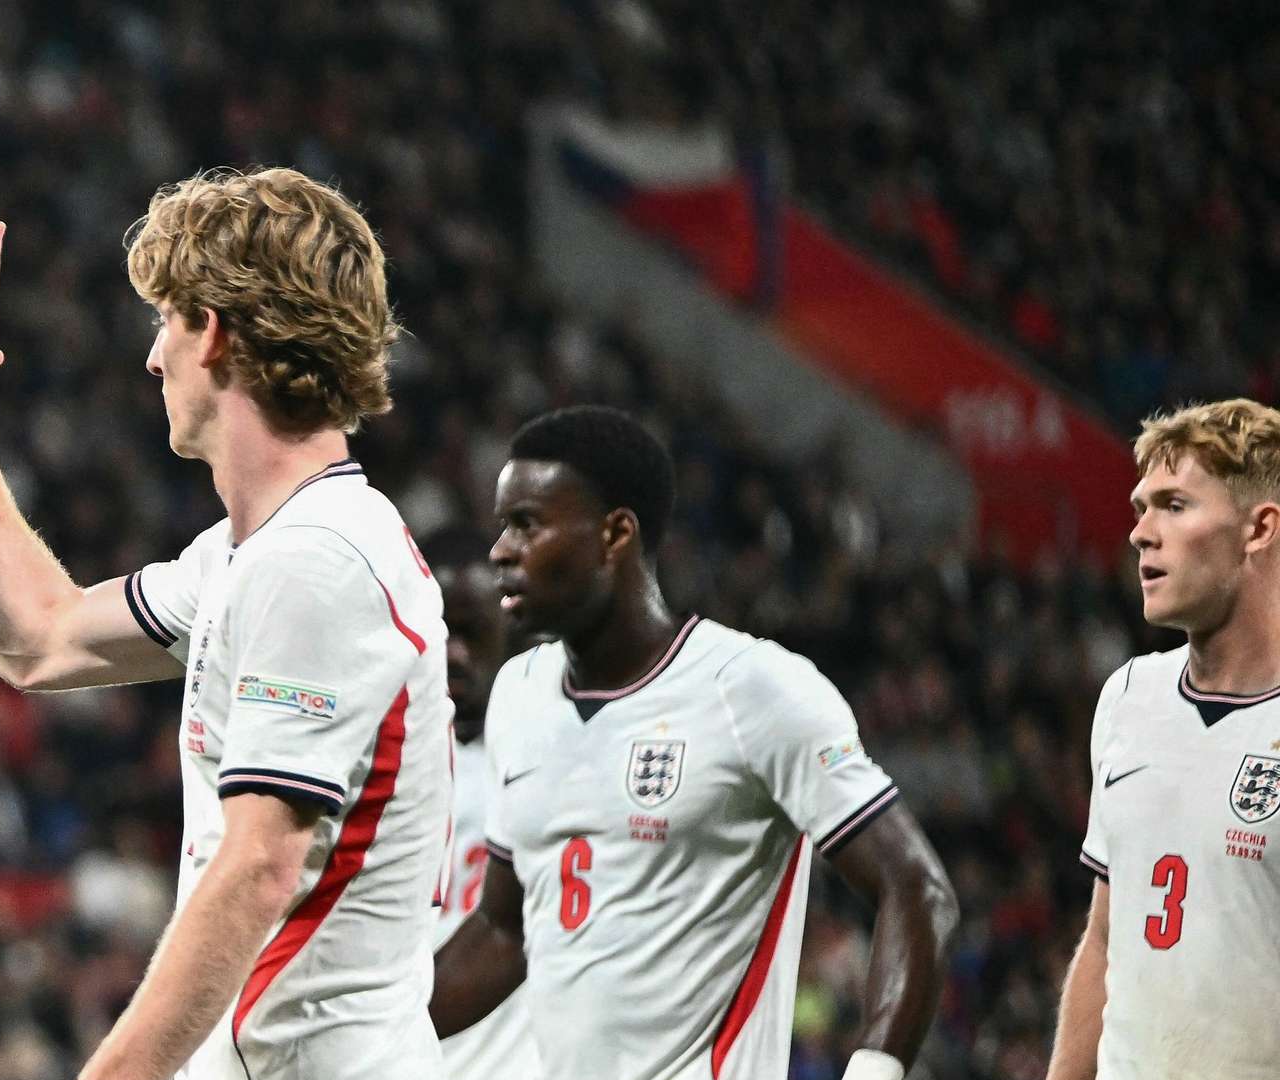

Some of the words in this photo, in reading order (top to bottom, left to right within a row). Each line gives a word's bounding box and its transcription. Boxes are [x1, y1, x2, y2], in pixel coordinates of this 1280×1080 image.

[237, 684, 336, 711] FOUNDATION
[1225, 830, 1267, 848] CZECHIA
[558, 836, 593, 932] 6
[1143, 854, 1189, 950] 3
